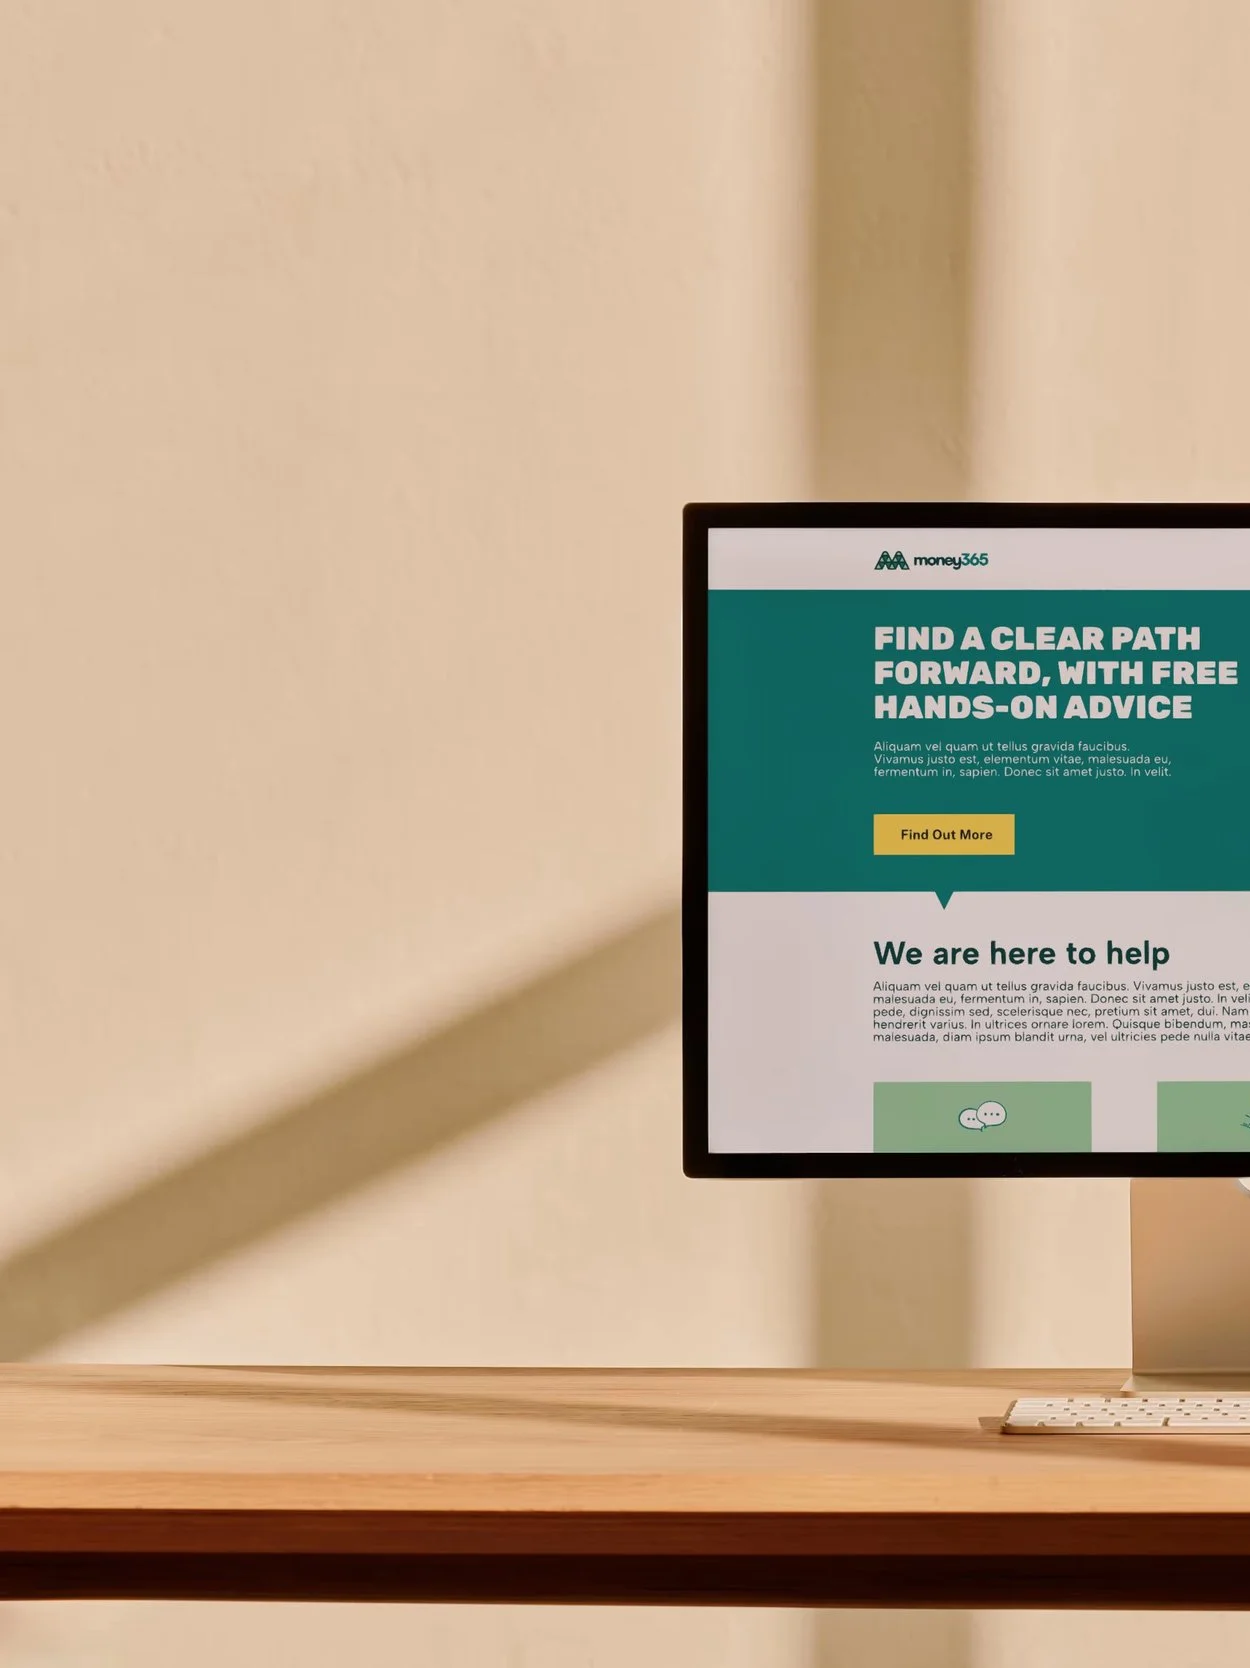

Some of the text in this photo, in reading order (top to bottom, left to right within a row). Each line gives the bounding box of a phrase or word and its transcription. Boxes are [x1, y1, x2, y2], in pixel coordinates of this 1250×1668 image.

[913, 552, 989, 571] money365
[875, 626, 1200, 651] FIND A CLEAR PATH
[874, 660, 1238, 687] FORWARD, WITH FREE
[874, 695, 1192, 720] HANDS-ON ADVICE
[874, 741, 1130, 754] Aliquam vel quam ut tellus gravida faucibus.
[874, 754, 1171, 766] Vivamus justo est, elementum vitae, malesuada eu,
[874, 766, 1171, 779] fermentum in, sapien. Donec sit amet justo. In velit.
[901, 829, 993, 840] Find Out More
[873, 940, 1170, 971] We are here to help
[873, 981, 921, 994] Aliquam
[924, 981, 941, 991] vel
[944, 983, 978, 993] quam
[981, 982, 993, 991] ut
[996, 981, 1027, 991] tellus
[1030, 981, 1074, 994] gravida
[1077, 980, 1129, 991] faucibus.
[1133, 981, 1183, 991] Vivamus
[1185, 981, 1215, 993] justo
[1218, 982, 1239, 992] est,
[873, 994, 936, 1004] malesuada
[939, 996, 956, 1005] eu,
[960, 993, 1025, 1004] fermentum
[1029, 994, 1042, 1005] in,
[1046, 994, 1087, 1006] sapien.
[1090, 993, 1128, 1004] Donec
[1132, 994, 1146, 1004] sit
[1149, 994, 1179, 1004] amet
[1182, 993, 1213, 1006] justo.
[1217, 993, 1227, 1003] In
[873, 1006, 905, 1019] pede,
[909, 1006, 965, 1019] dignissim
[969, 1006, 993, 1018] sed,
[997, 1006, 1063, 1018] scelerisque
[1067, 1008, 1091, 1018] nec,
[1095, 1006, 1140, 1018] pretium
[1144, 1006, 1157, 1016] sit
[1161, 1007, 1193, 1018] amet,
[1197, 1006, 1218, 1016] dui.
[1222, 1006, 1249, 1016] Nam
[873, 1018, 926, 1030] hendrerit
[930, 1019, 967, 1030] varius.
[971, 1019, 981, 1029] In
[985, 1019, 1028, 1029] ultrices
[1031, 1021, 1069, 1029] ornare
[1072, 1019, 1108, 1029] lorem.
[1112, 1018, 1161, 1031] Quisque
[1164, 1018, 1226, 1030] bibendum,
[873, 1032, 939, 1043] malesuada,
[943, 1032, 972, 1042] diam
[976, 1032, 1011, 1044] ipsum
[1014, 1031, 1054, 1042] blandit
[1058, 1034, 1087, 1043] urna,
[1090, 1031, 1107, 1042] vel
[1111, 1031, 1157, 1042] ultricies
[1160, 1031, 1190, 1044] pede
[1194, 1031, 1220, 1041] nulla
